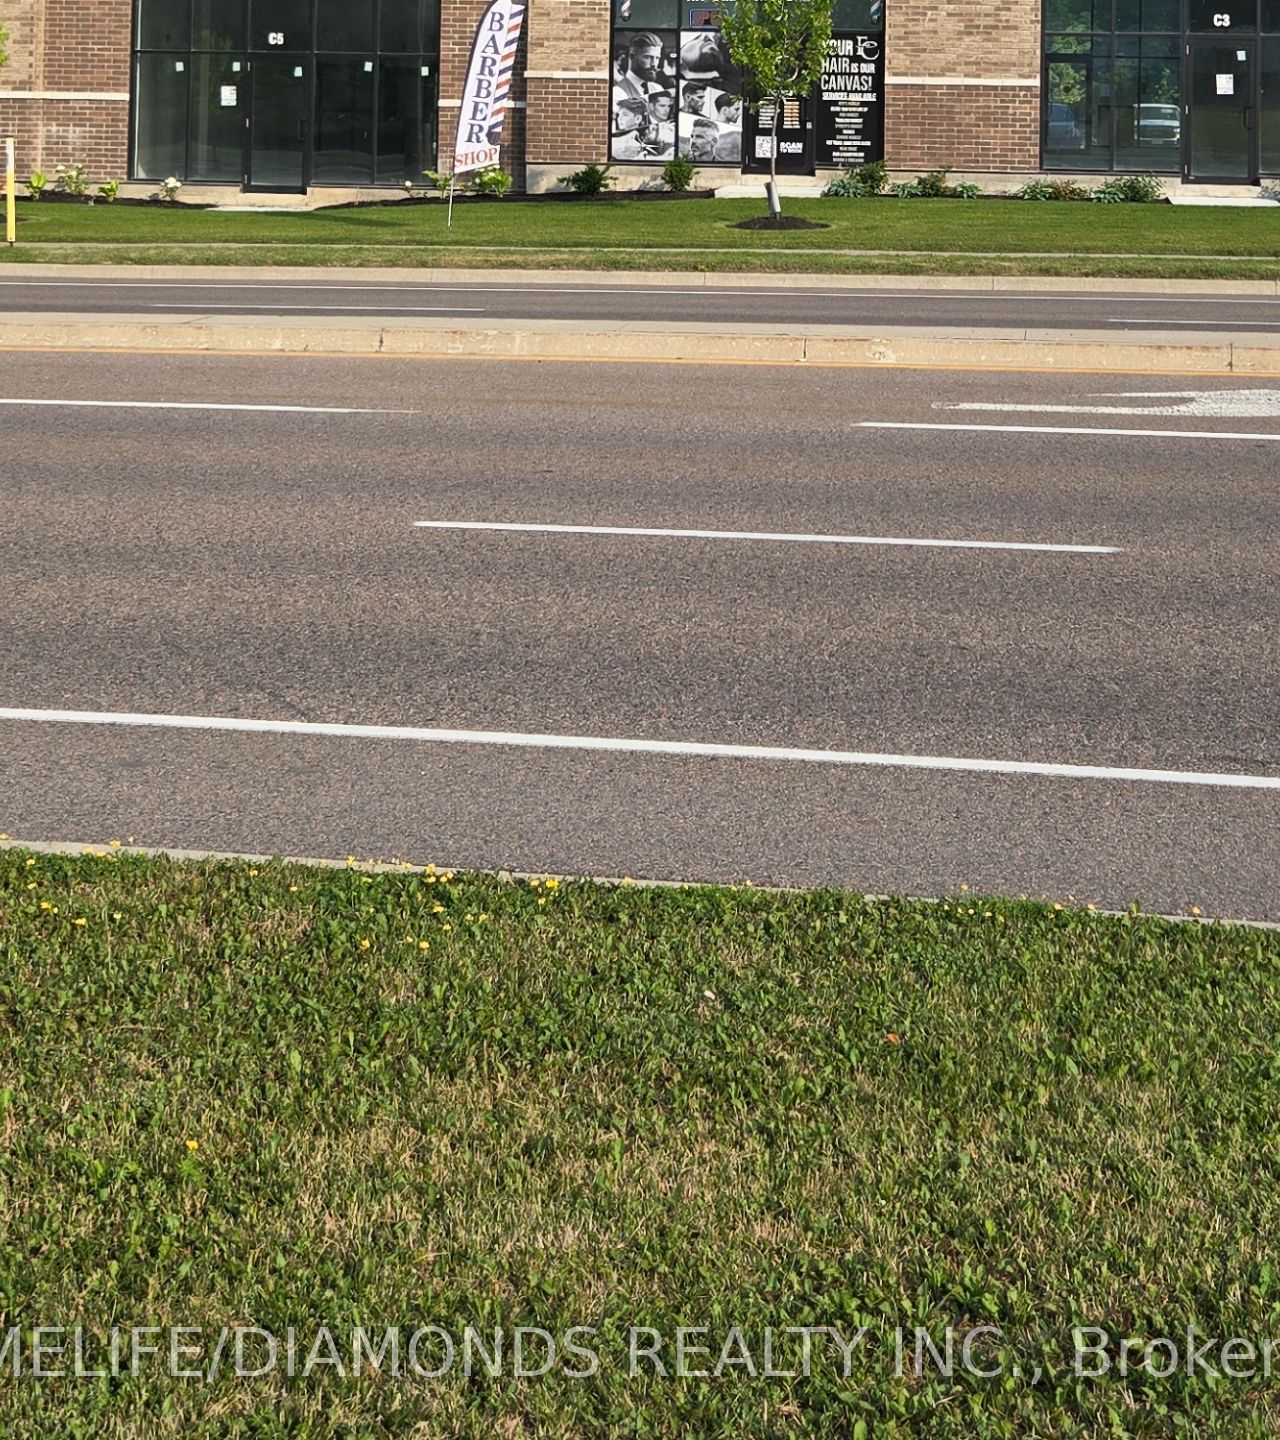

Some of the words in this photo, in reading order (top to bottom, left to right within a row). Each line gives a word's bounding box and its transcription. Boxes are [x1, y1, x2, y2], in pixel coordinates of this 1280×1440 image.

[1213, 13, 1231, 27] C3
[268, 32, 284, 45] C5
[822, 39, 854, 56] YOUR
[821, 57, 850, 73] HAIR
[851, 63, 859, 73] IS
[860, 63, 876, 74] OUR
[465, 11, 505, 144] BARBER
[821, 74, 873, 91] CANVAS!
[780, 142, 803, 150] SCAN
[455, 147, 498, 168] SHOP
